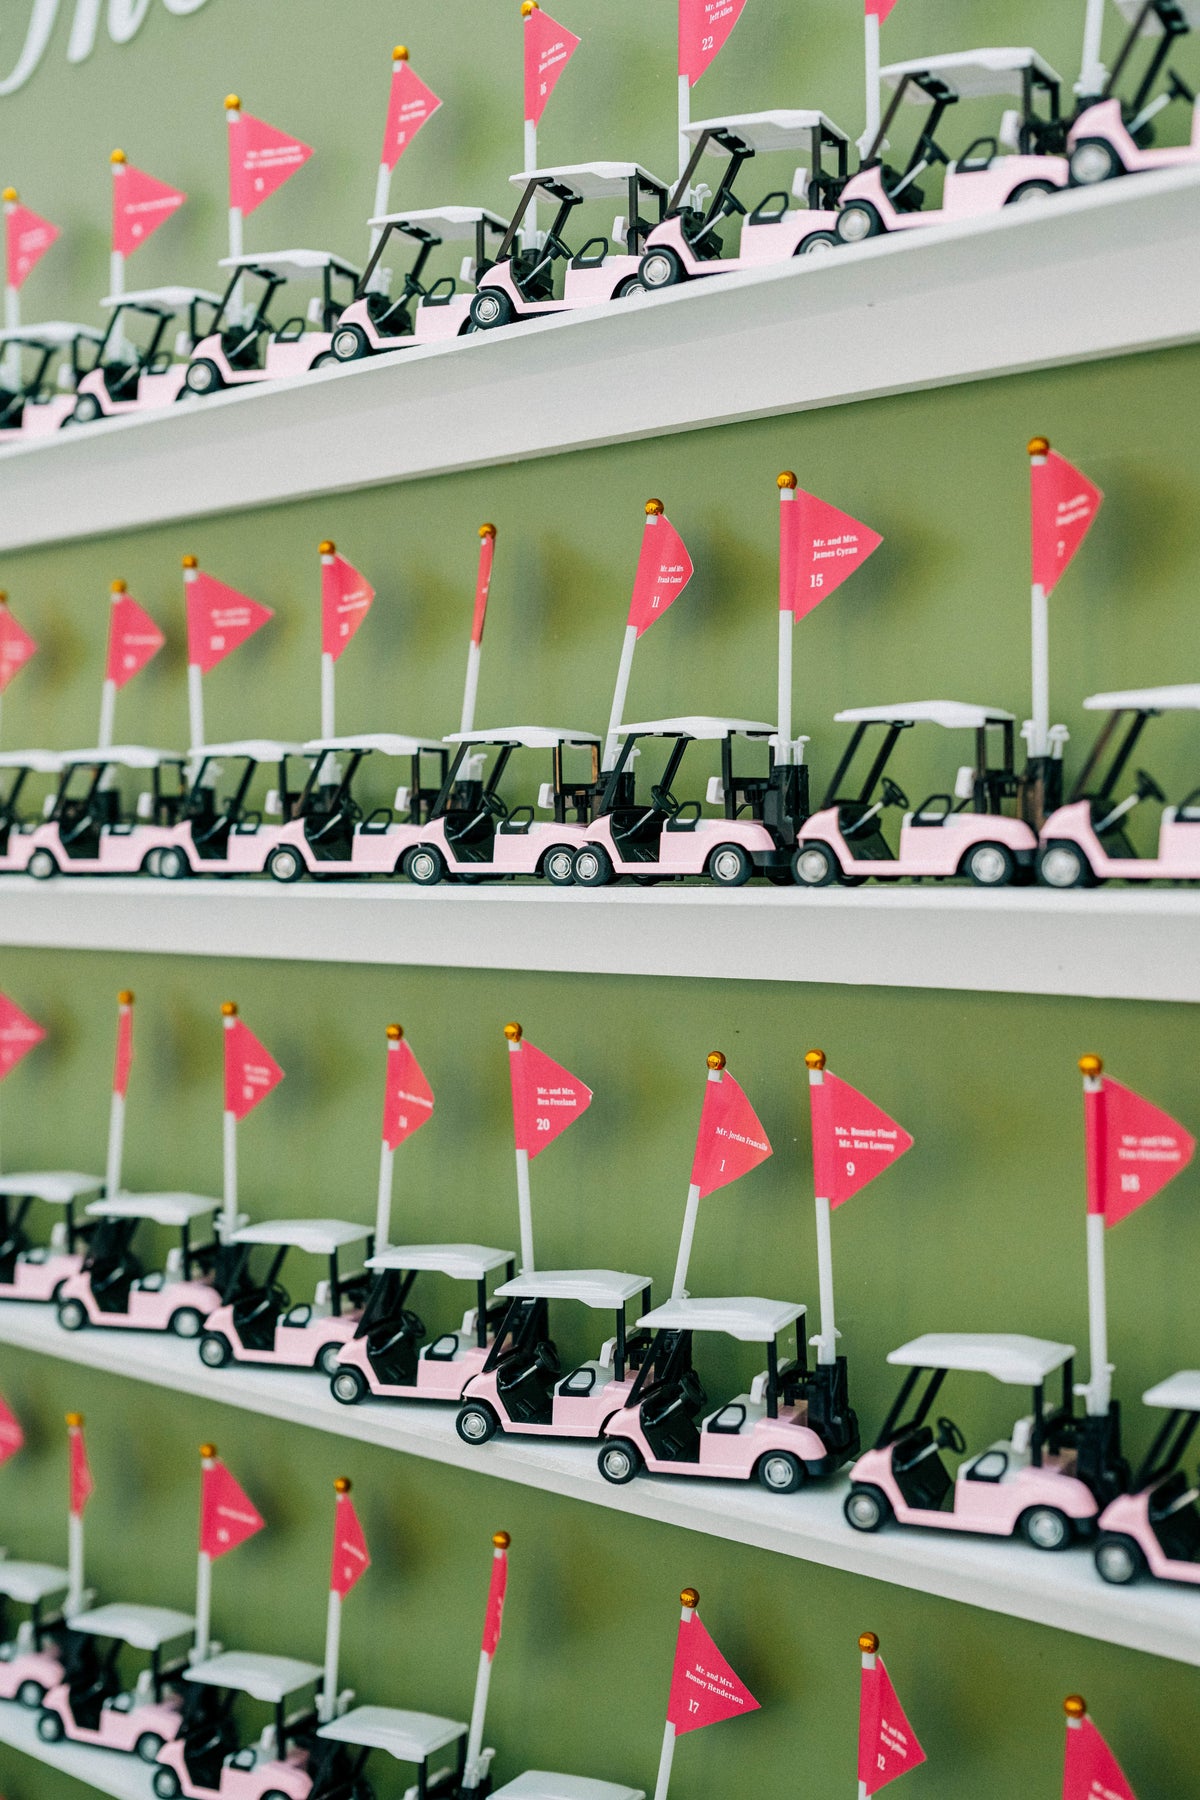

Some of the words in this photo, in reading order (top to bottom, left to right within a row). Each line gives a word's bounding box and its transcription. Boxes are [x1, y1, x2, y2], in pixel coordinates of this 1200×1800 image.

[705, 3, 715, 12] Mr.
[709, 10, 720, 24] Jeff
[720, 6, 733, 17] Allen
[702, 36, 713, 51] 22
[813, 539, 826, 547] Mr.
[827, 536, 841, 546] and
[842, 534, 859, 544] Mrs.
[813, 551, 835, 561] James
[810, 573, 824, 588] 15
[651, 596, 660, 608] 11
[536, 1087, 549, 1095] Mr.
[549, 1087, 561, 1095] and
[561, 1087, 576, 1095] Mrs.
[536, 1118, 551, 1131] 20
[716, 1126, 728, 1137] Mr.
[728, 1130, 746, 1143] Jordan
[839, 1138, 853, 1148] Mr.
[719, 1159, 726, 1172] 1
[846, 1161, 855, 1177] 9
[695, 1663, 706, 1676] Mr.
[706, 1671, 719, 1682] and
[719, 1676, 735, 1689] Mrs.
[707, 1683, 744, 1705] Henderson
[688, 1699, 700, 1714] 17
[877, 1753, 886, 1771] 12
